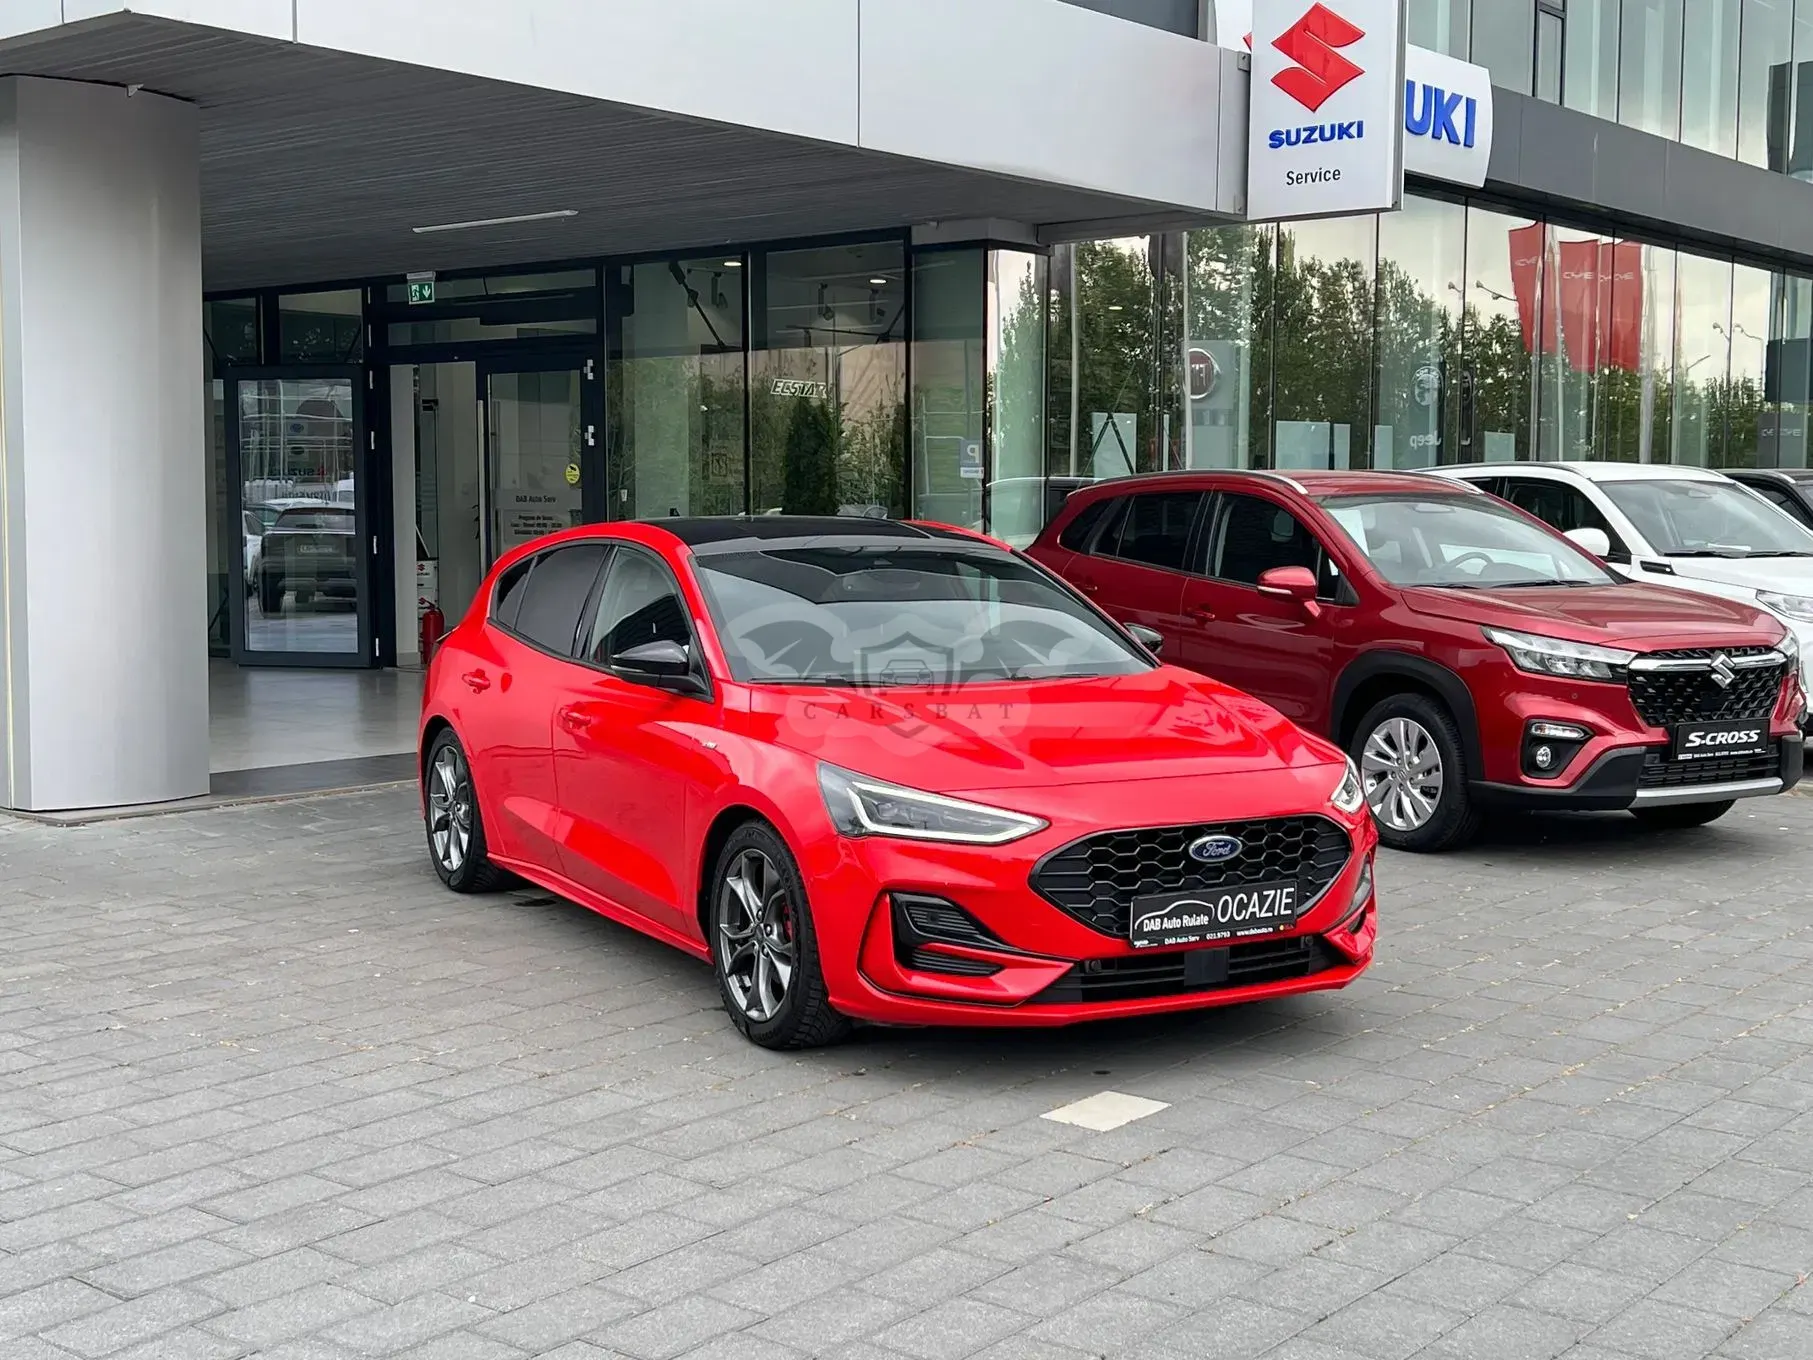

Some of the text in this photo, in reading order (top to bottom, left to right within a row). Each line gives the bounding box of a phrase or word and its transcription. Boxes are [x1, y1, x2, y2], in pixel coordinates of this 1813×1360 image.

[1268, 120, 1364, 149] SUZUKI
[1286, 167, 1341, 186] Service
[1202, 841, 1231, 857] Ford
[1217, 887, 1295, 923] OCAZIE
[1143, 914, 1209, 932] DAB Auto Rulate
